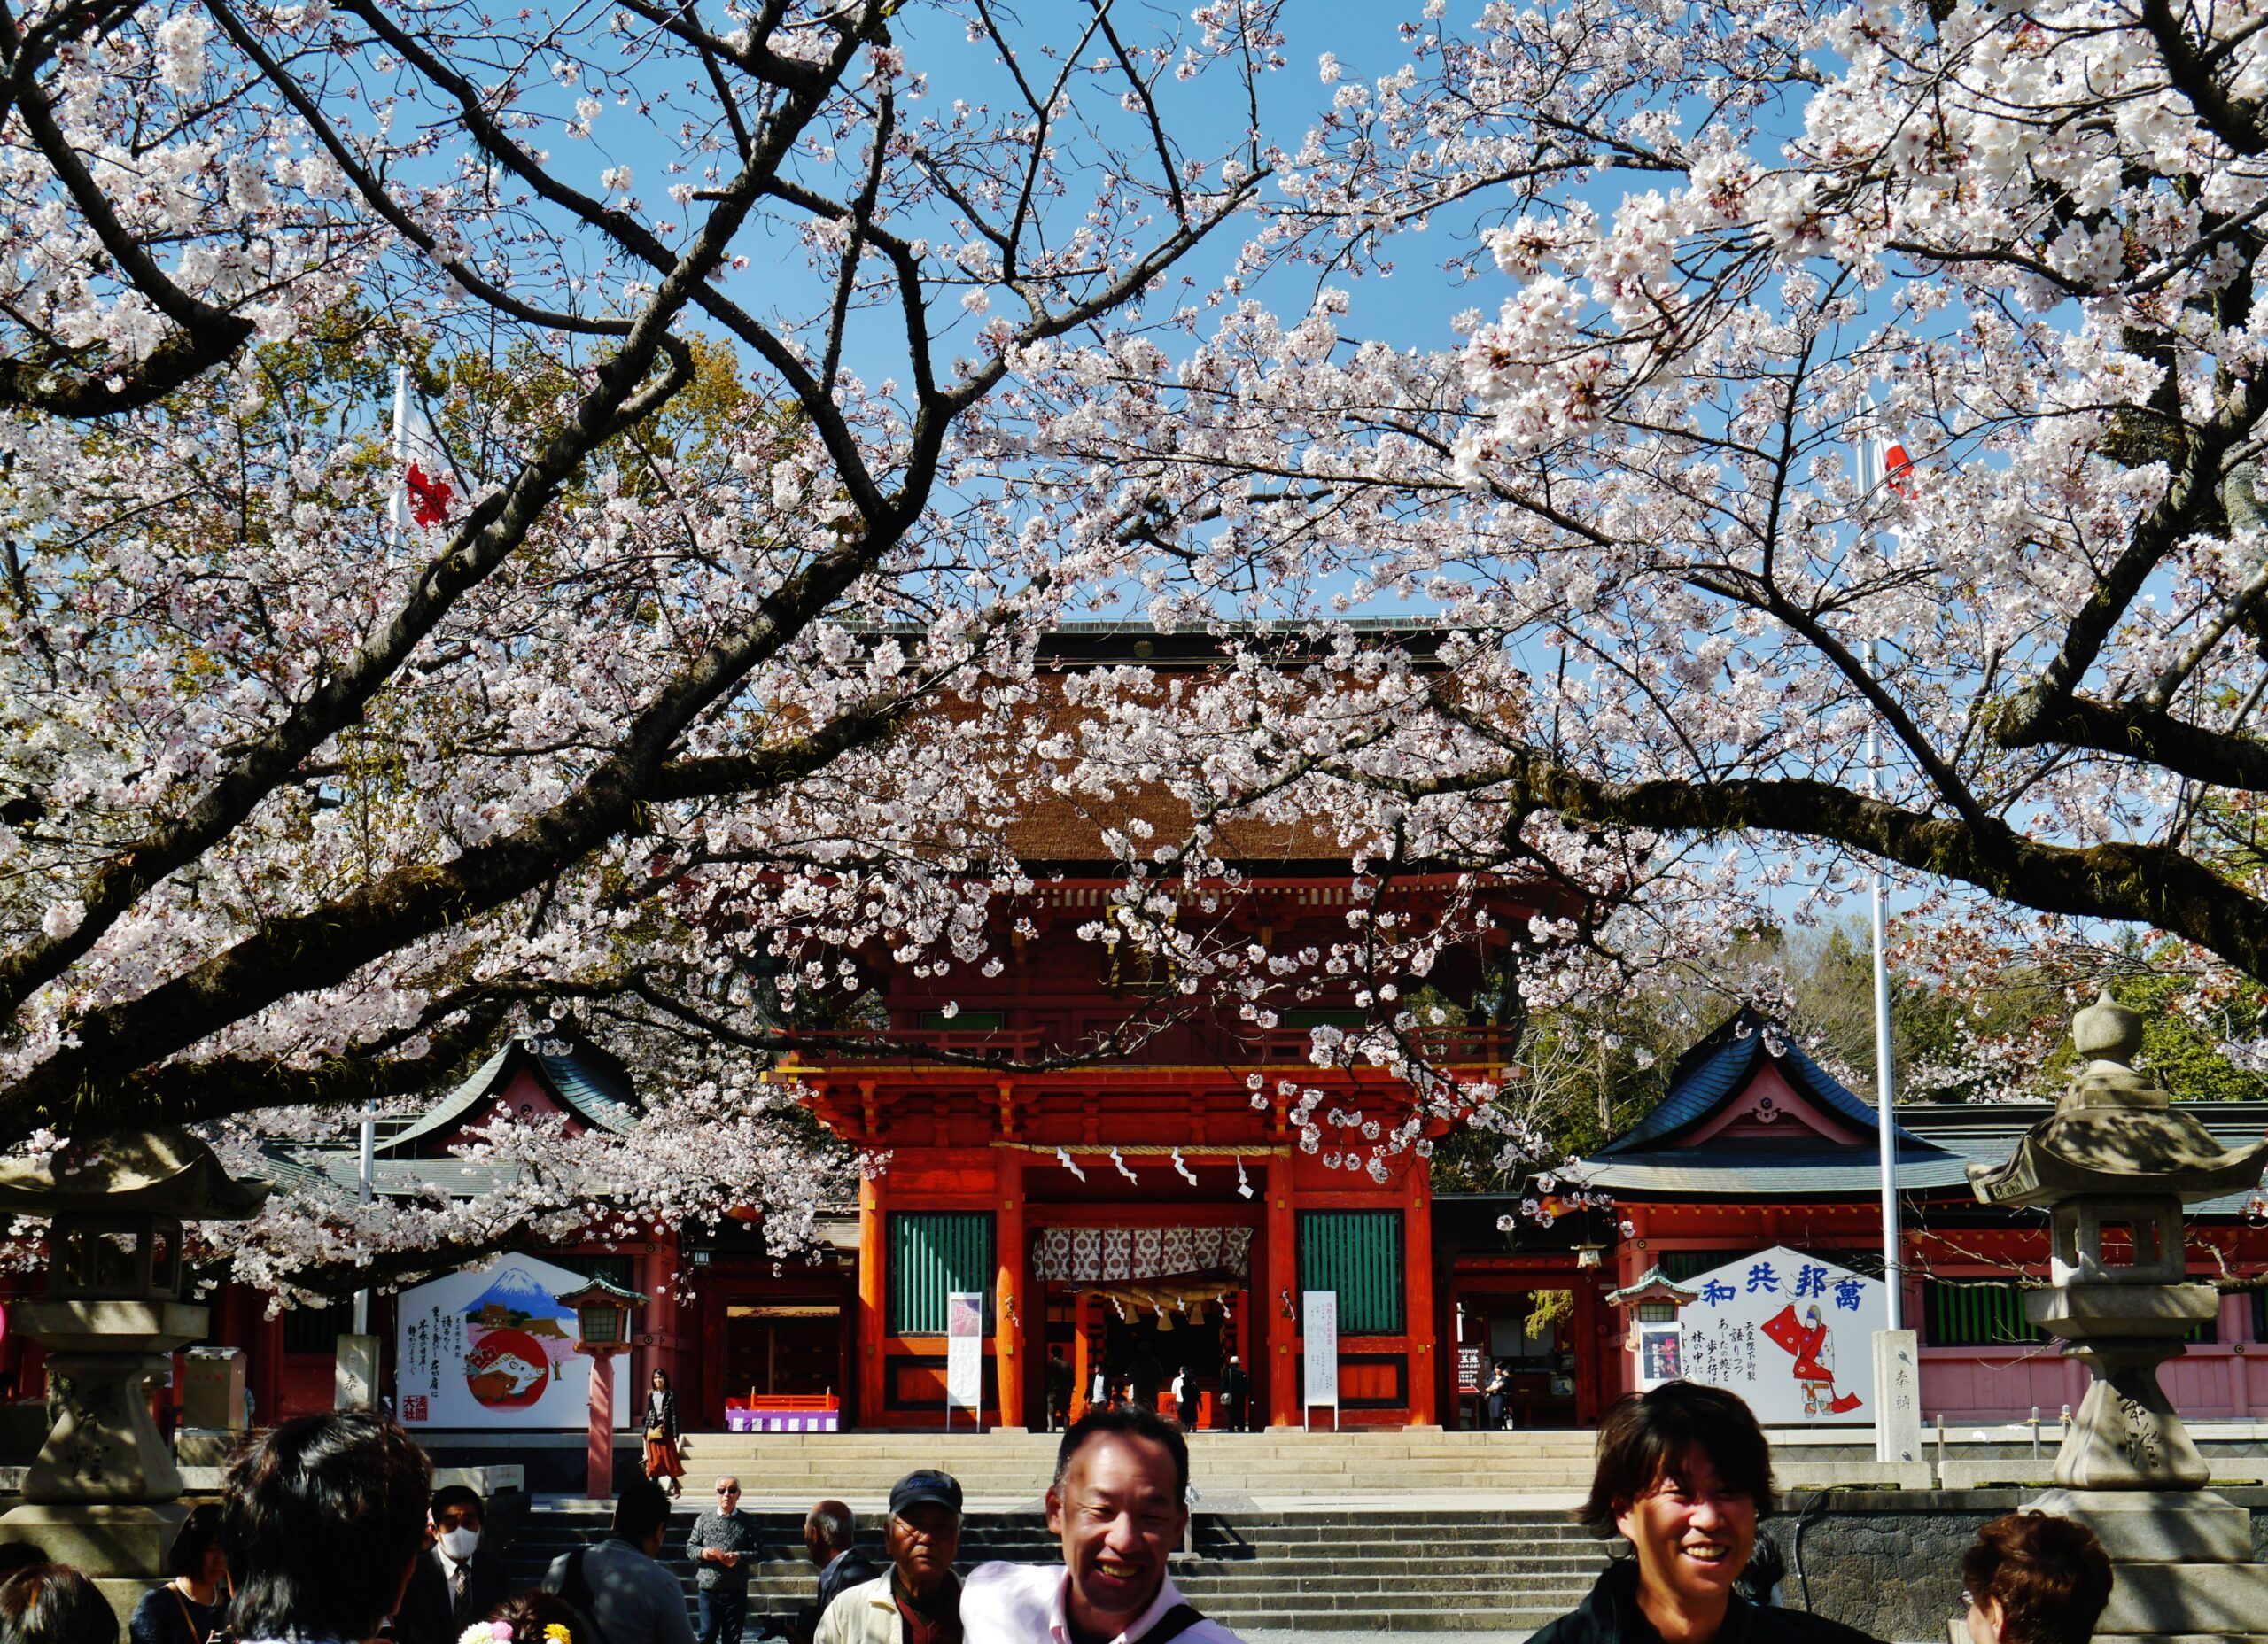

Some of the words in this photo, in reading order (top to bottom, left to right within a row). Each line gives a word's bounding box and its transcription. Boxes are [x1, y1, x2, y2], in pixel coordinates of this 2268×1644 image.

[1691, 1330, 1705, 1373] 林の中に
[1729, 1328, 1744, 1375] 語りつつ
[1744, 1321, 1756, 1381] 天皇陛下御製
[1896, 1370, 1910, 1410] 奉納
